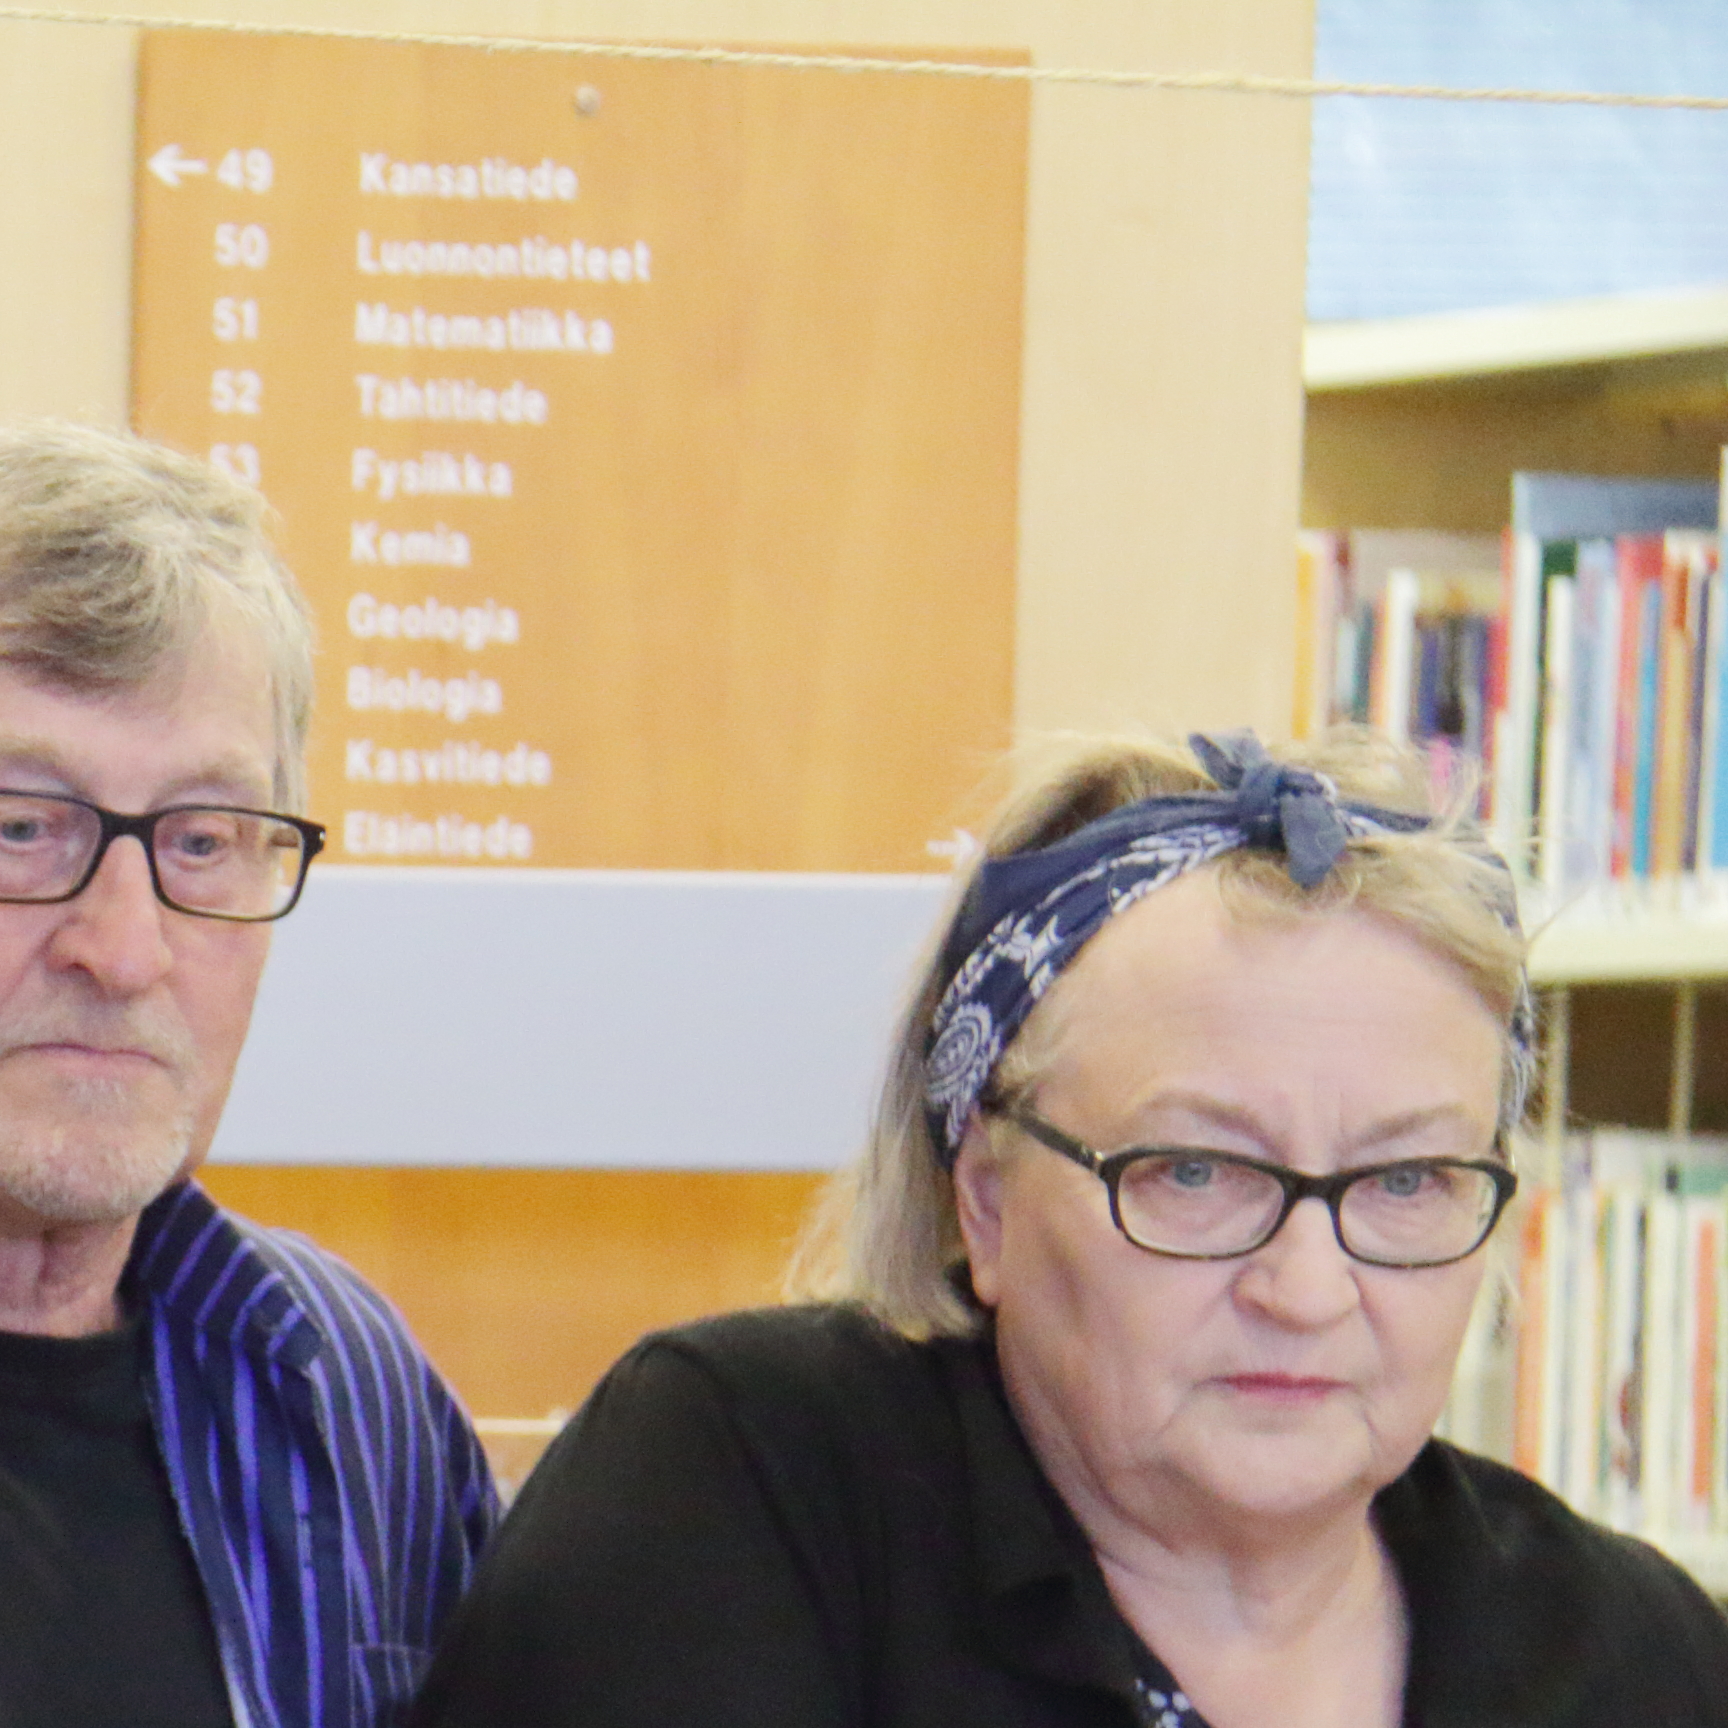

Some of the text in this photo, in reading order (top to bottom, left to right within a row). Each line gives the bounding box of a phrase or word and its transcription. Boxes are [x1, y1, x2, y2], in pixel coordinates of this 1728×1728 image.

[217, 147, 580, 201] 49 Kansatiede
[214, 222, 652, 284] 50 Luonnontieteet
[212, 297, 615, 354] 51 Matematiikka
[210, 369, 263, 415] 52
[351, 447, 515, 500] Fysiikka
[350, 520, 472, 568] Kemia
[348, 592, 521, 652] Geologia
[347, 665, 505, 722] Biologia
[346, 738, 553, 787] Kasvitiede
